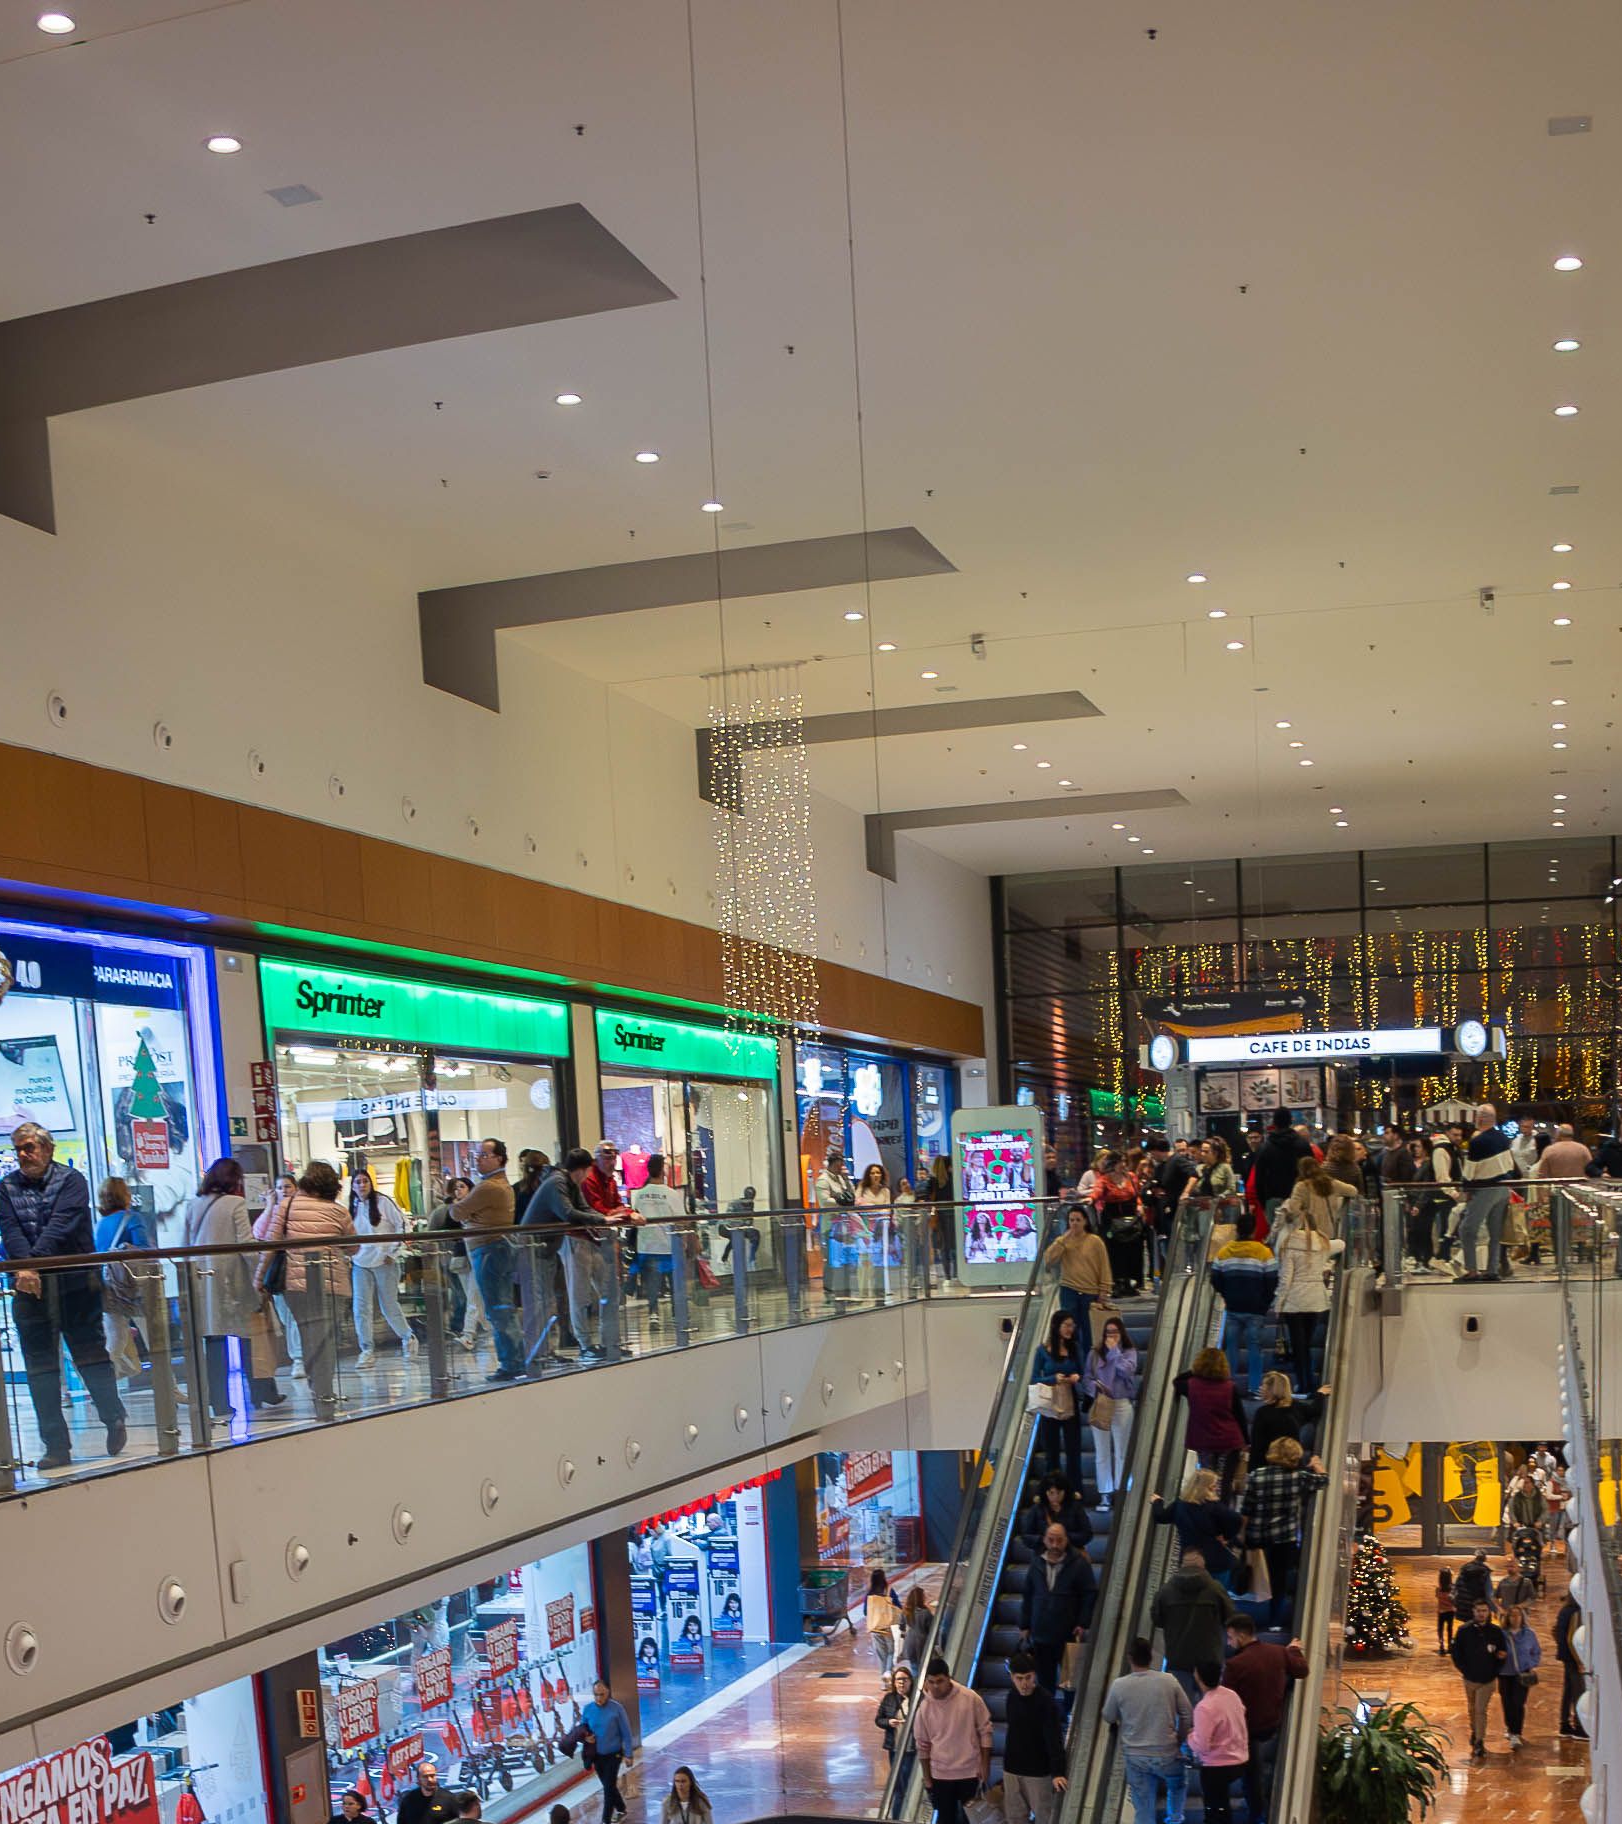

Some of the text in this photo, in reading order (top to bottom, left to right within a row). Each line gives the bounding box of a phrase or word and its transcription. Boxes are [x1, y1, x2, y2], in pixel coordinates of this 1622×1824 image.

[296, 979, 386, 1019] Sprinter
[614, 1023, 667, 1053] Sprinter
[1249, 1037, 1371, 1054] CAFE DE INDIAS
[118, 1048, 173, 1068] PROST
[103, 1755, 150, 1818] PAZ
